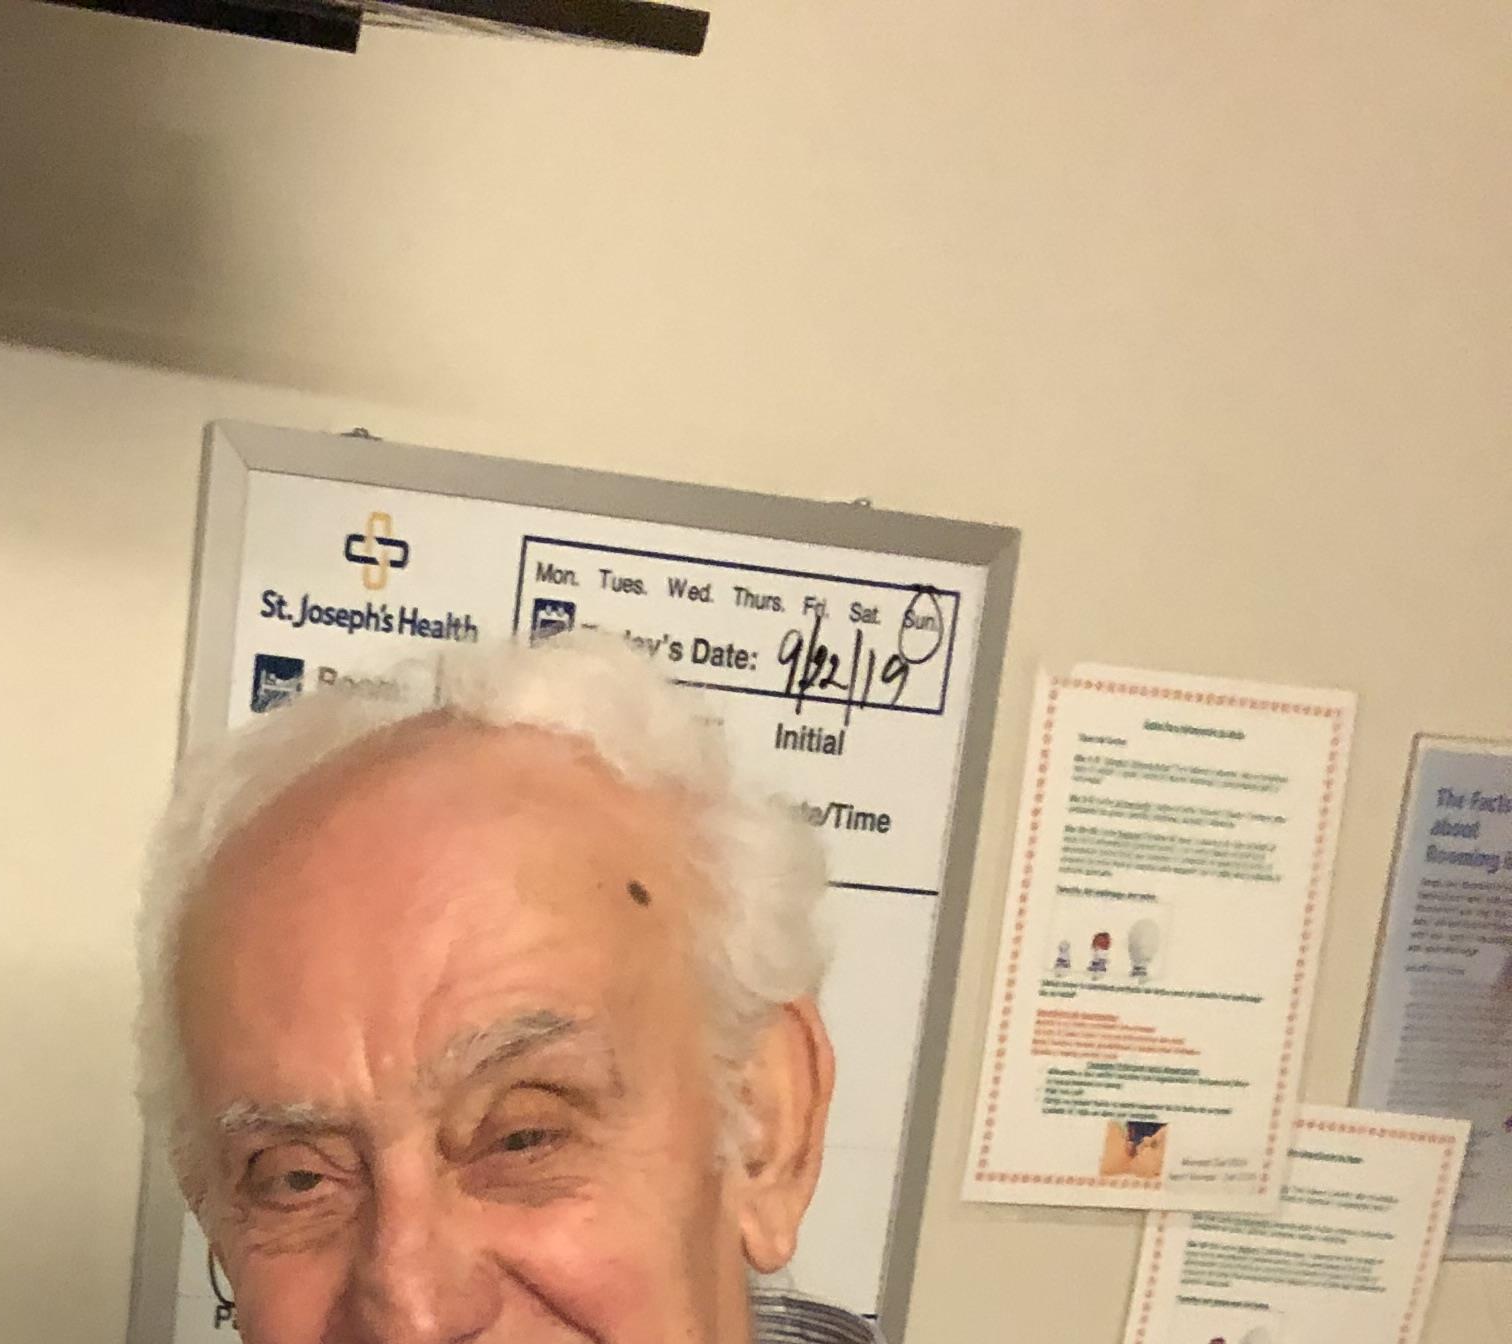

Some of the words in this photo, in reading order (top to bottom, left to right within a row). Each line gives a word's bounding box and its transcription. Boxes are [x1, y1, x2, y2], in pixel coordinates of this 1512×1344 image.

[535, 561, 580, 586] Mon.
[599, 568, 648, 596] Tues.
[668, 576, 715, 603] Wed.
[733, 585, 786, 613] Thurs.
[849, 601, 881, 625] Sat.
[260, 589, 293, 621] St.
[292, 592, 395, 635] Joseph's
[398, 605, 480, 643] Health
[690, 636, 758, 671] Date:
[774, 722, 846, 757] Initial
